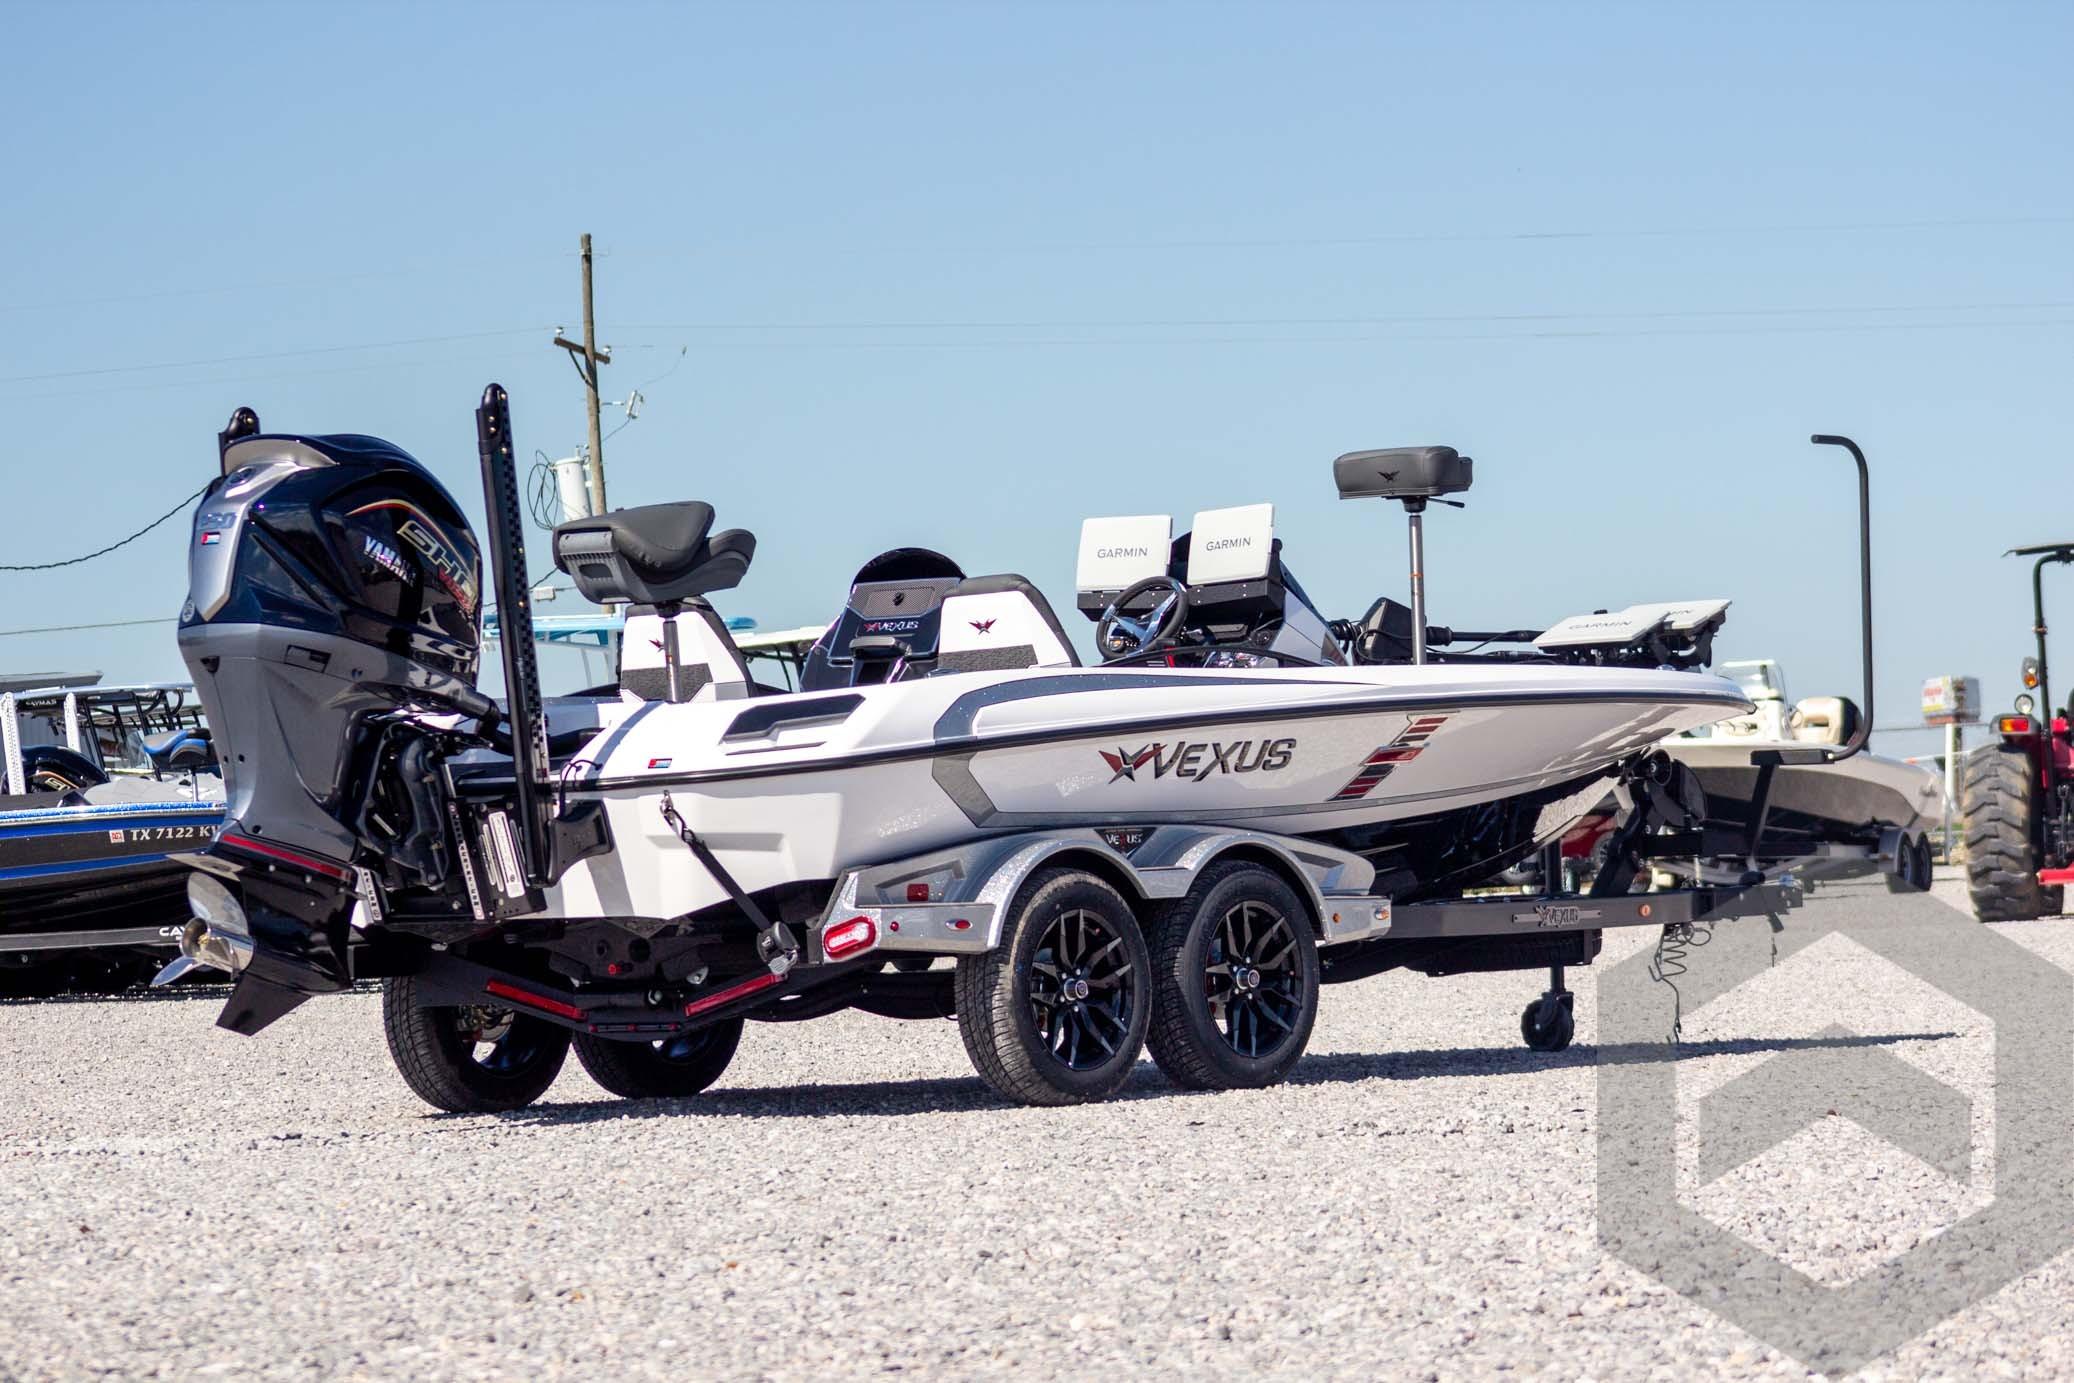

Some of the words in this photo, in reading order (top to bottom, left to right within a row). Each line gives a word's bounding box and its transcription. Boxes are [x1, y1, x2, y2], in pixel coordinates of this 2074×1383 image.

[1206, 536, 1251, 551] GARMIN
[1097, 547, 1148, 559] GARMIN
[877, 620, 919, 632] VEXUS
[1152, 738, 1297, 783] VEXUS
[130, 828, 151, 841] TX
[156, 826, 195, 840] 7122
